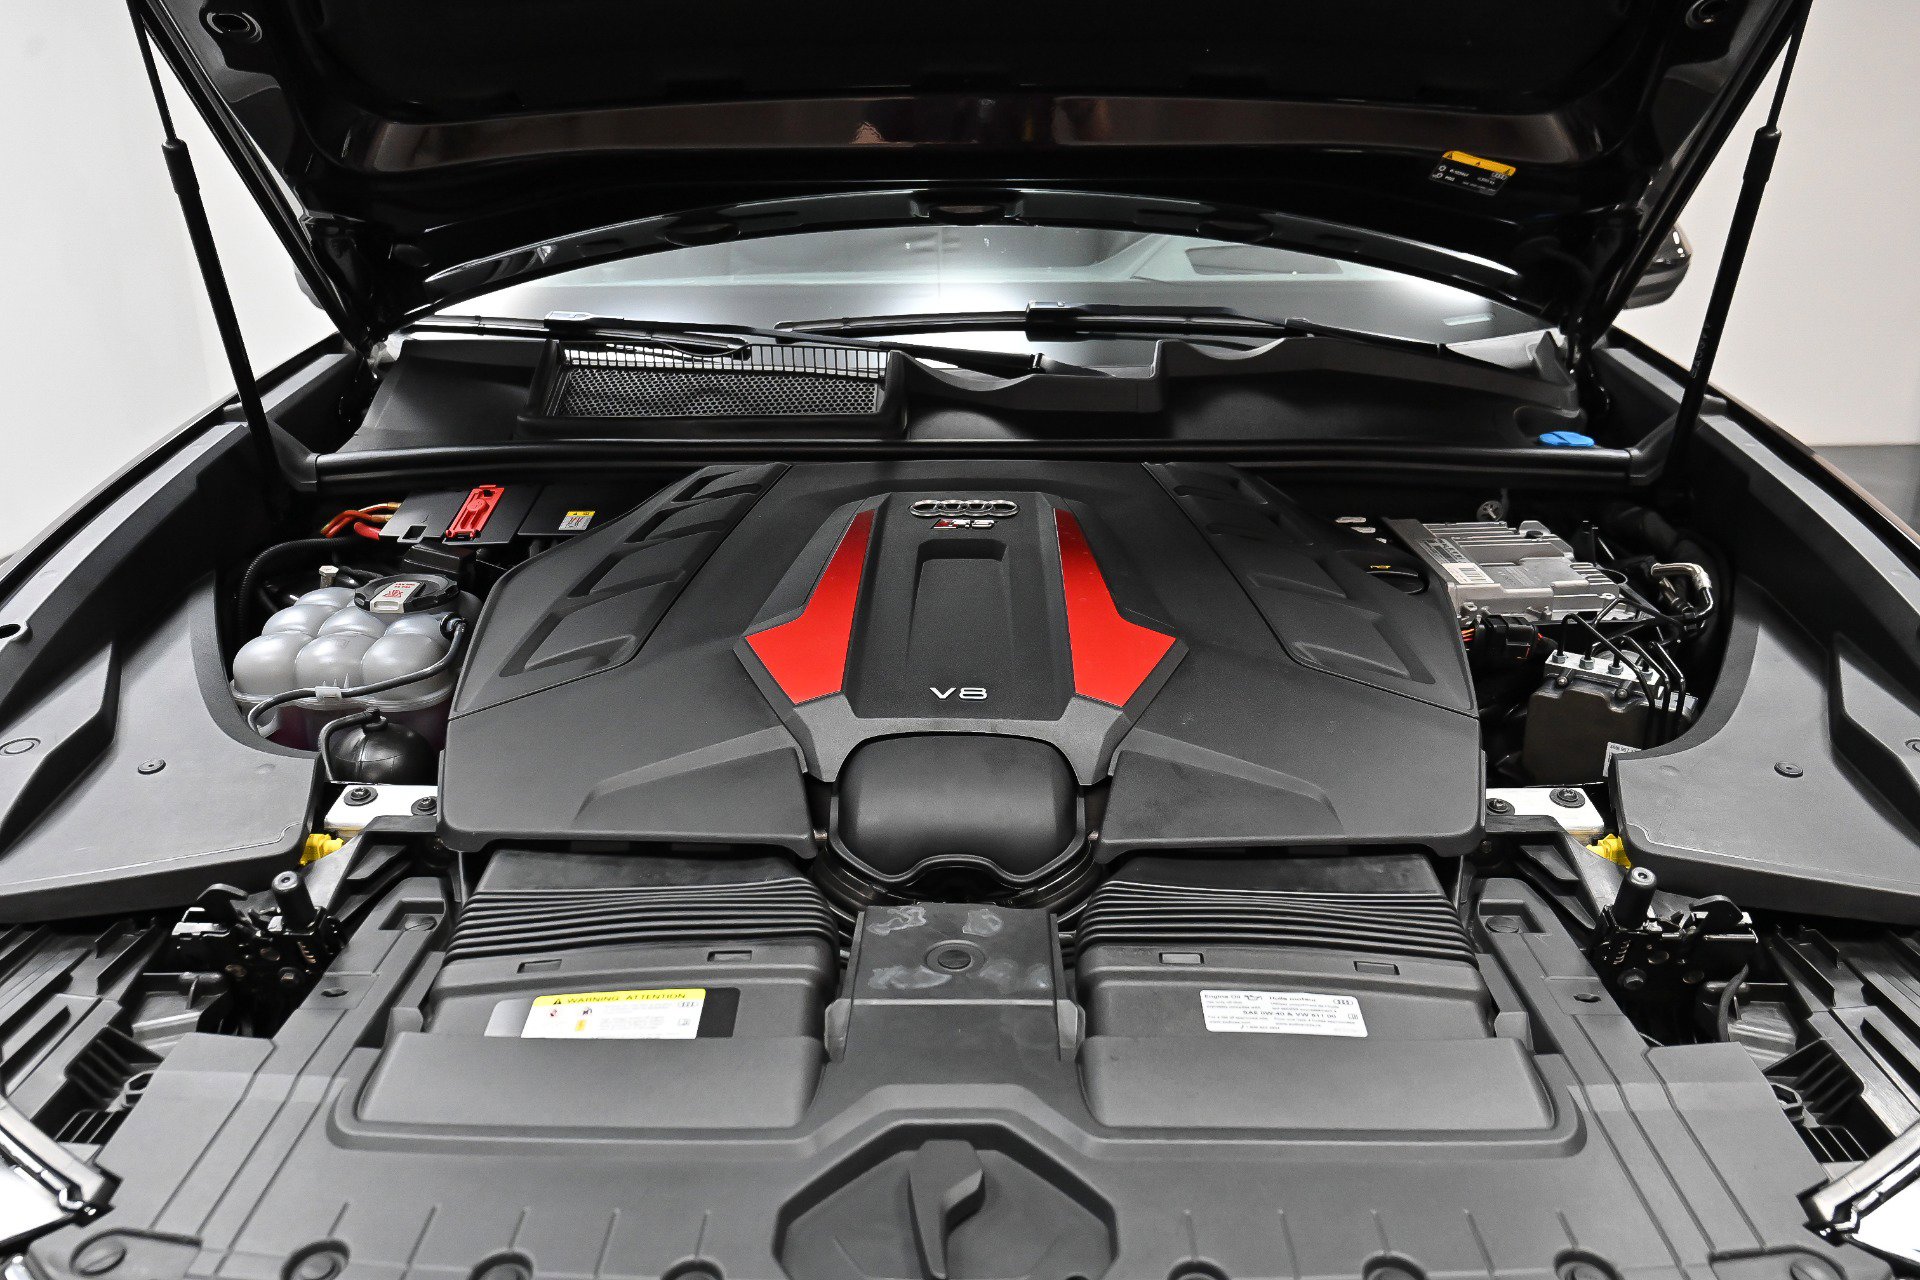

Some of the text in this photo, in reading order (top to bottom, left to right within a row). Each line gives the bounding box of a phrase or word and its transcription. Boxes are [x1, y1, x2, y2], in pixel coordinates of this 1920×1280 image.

[929, 687, 988, 700] V8
[567, 993, 686, 1004] WARNING ATTENTION
